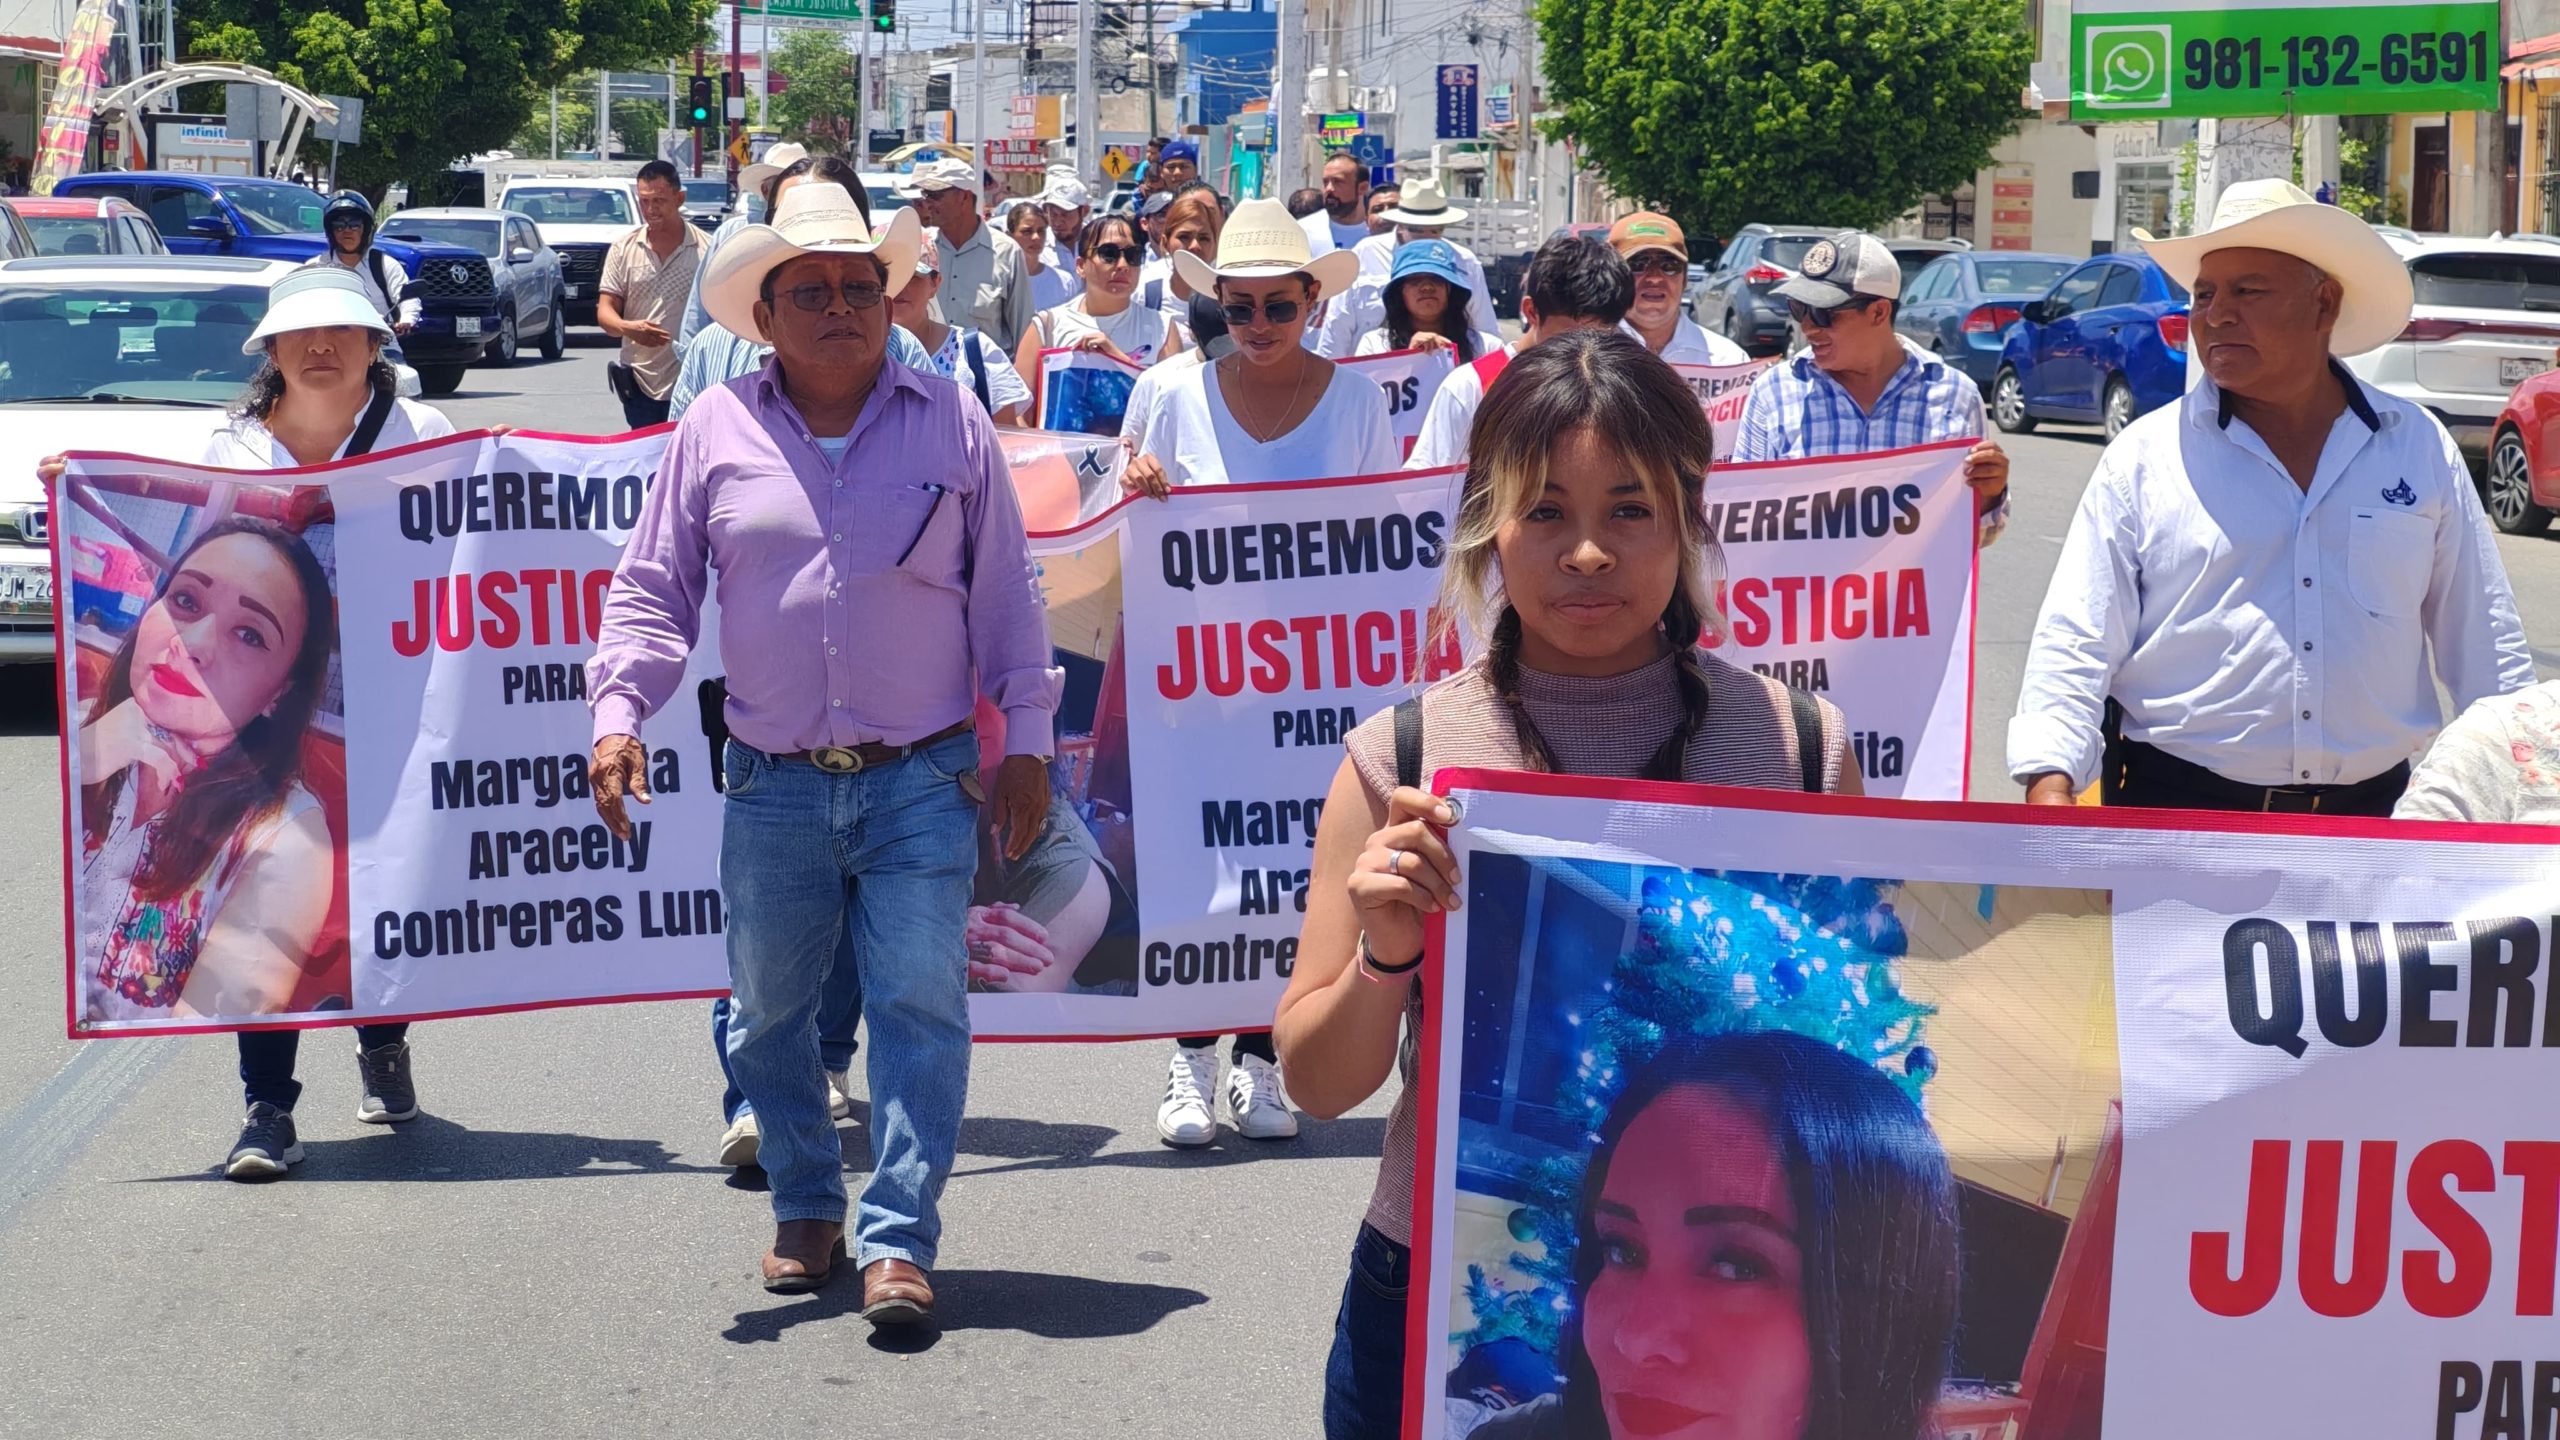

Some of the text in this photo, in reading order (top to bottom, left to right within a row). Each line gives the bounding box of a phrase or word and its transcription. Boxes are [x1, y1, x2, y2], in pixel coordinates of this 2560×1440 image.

[2184, 30, 2488, 90] 981-132-6591
[399, 471, 657, 545] QUEREMO
[1161, 510, 1446, 592] QUEREMOS
[502, 663, 587, 705] PARA
[1156, 606, 1464, 701] JUSTICIA
[468, 820, 653, 881] Aracely
[638, 887, 729, 939] Lun
[2188, 1138, 2560, 1319] JUST
